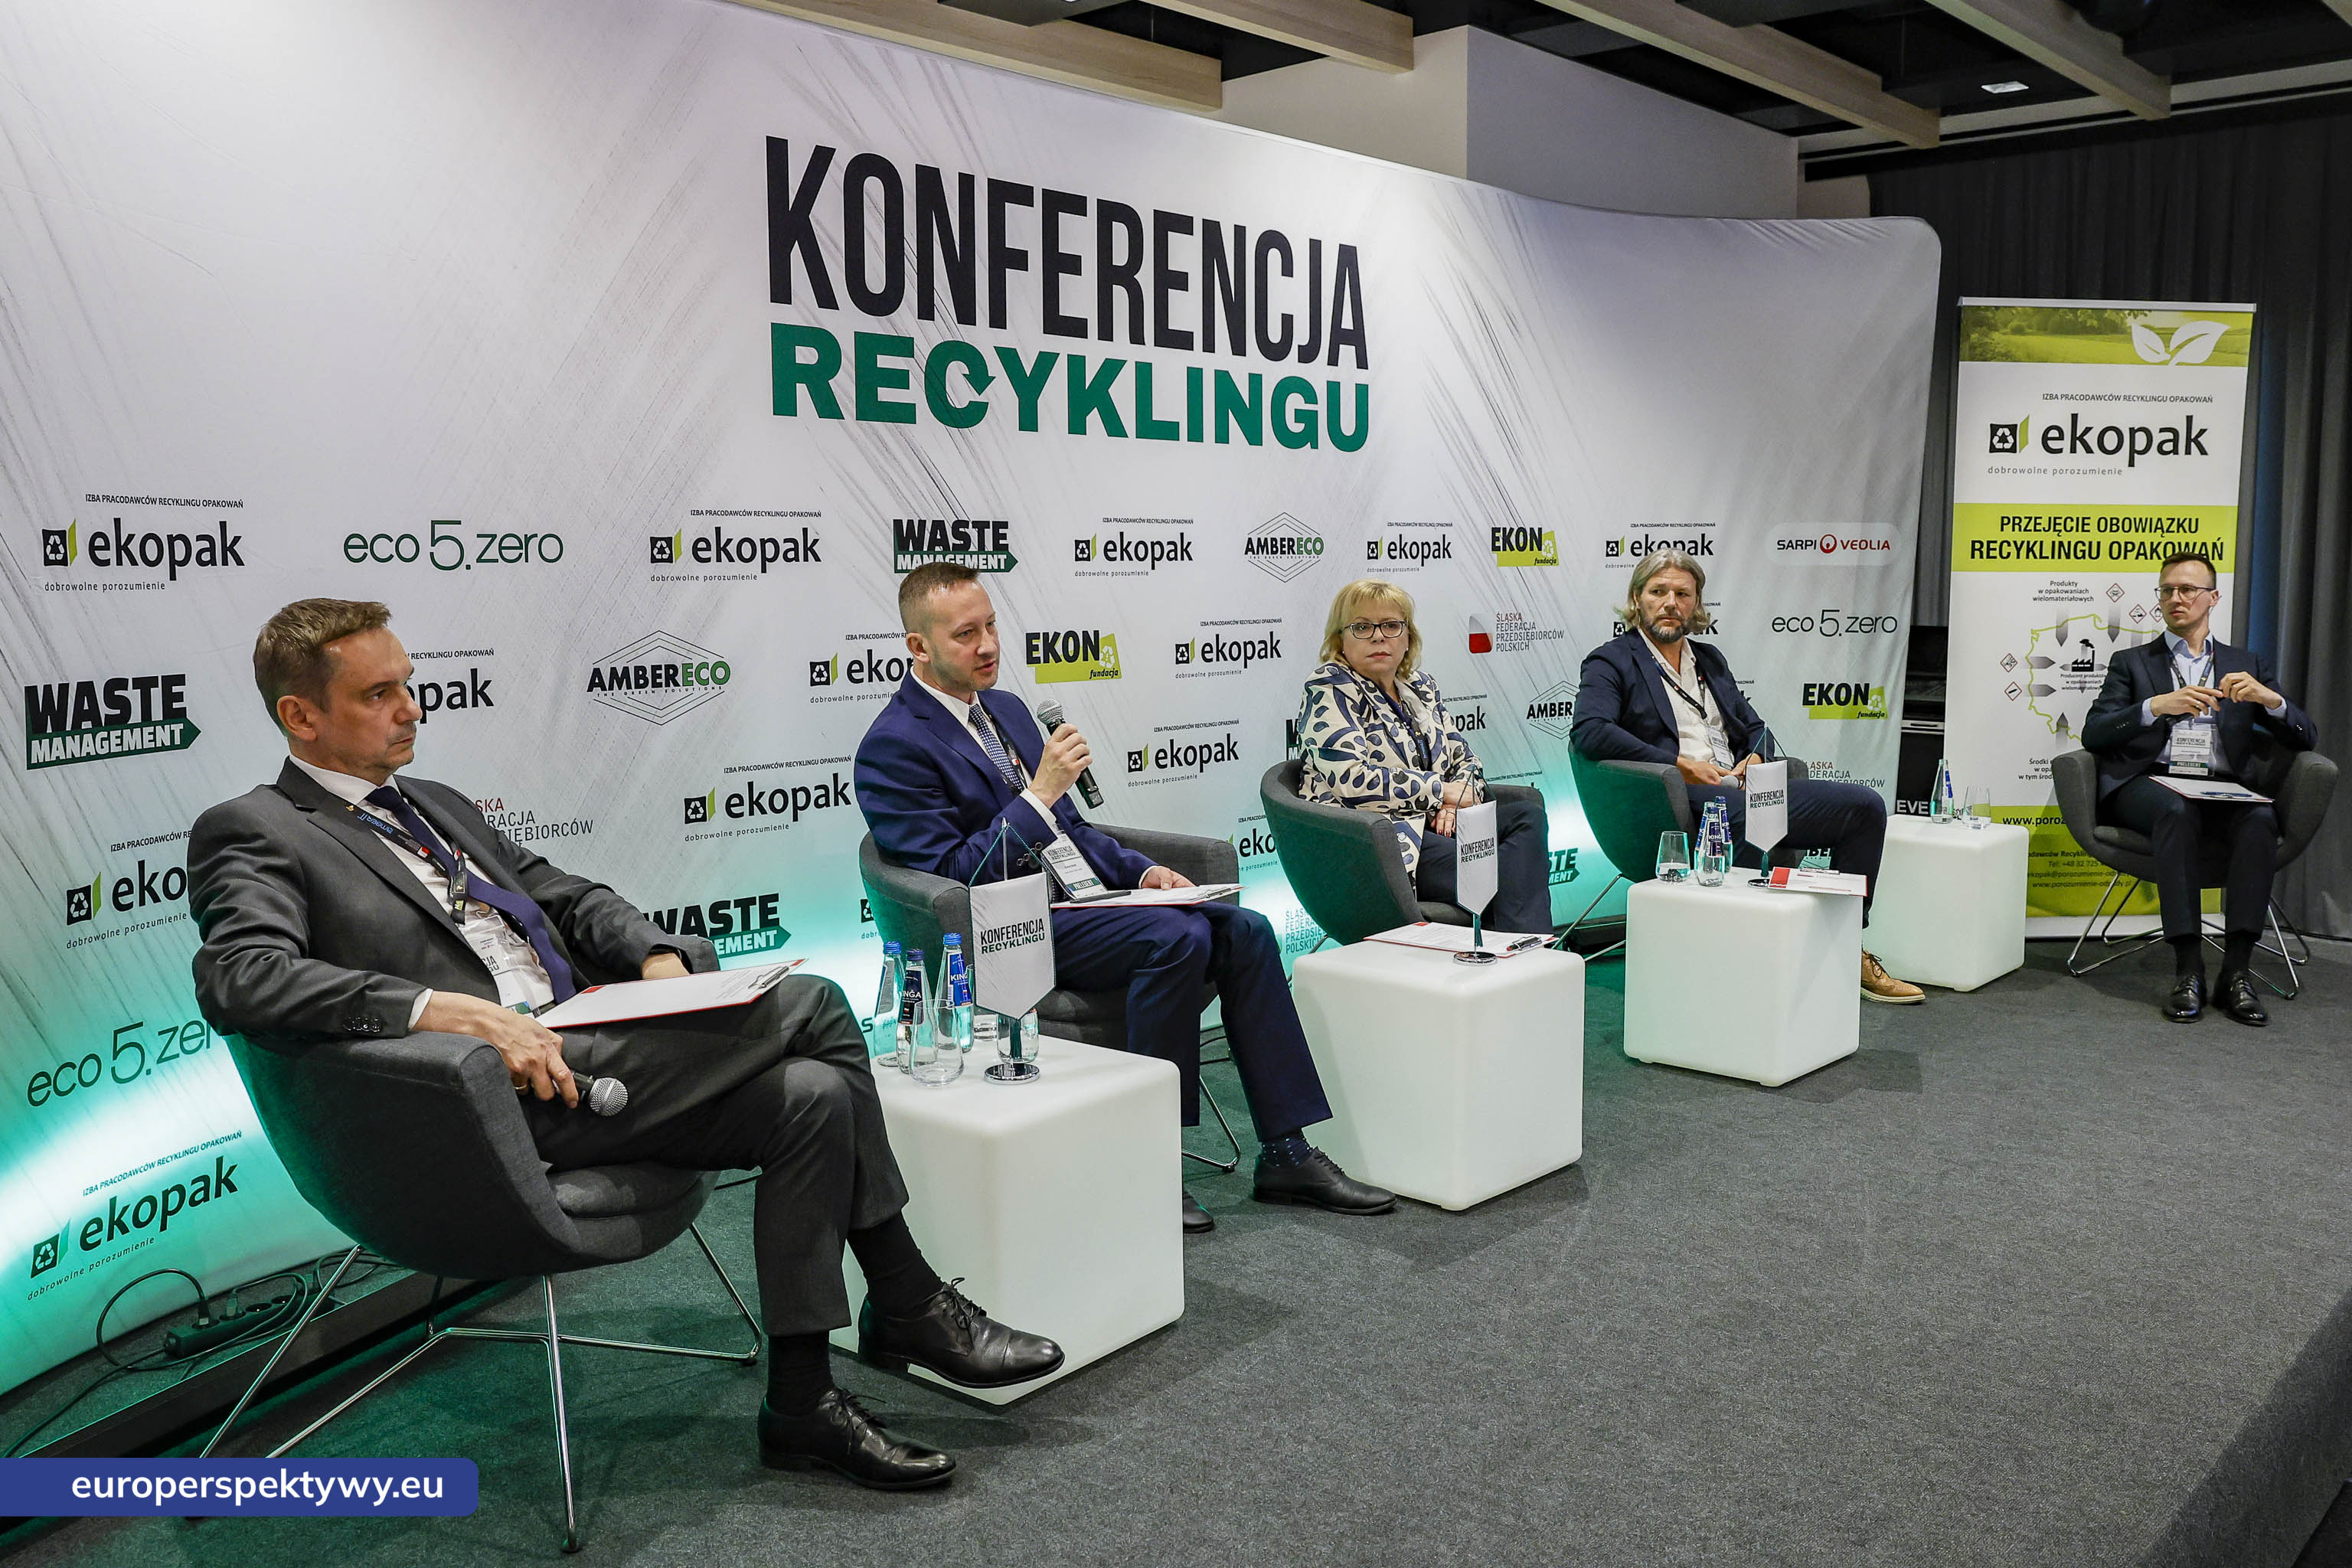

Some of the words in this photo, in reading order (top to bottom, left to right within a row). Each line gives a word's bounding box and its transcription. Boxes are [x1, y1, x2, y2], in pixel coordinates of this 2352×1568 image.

[766, 134, 1369, 371] KONFERENCJA
[770, 322, 1370, 452] RECYKLINGU
[2060, 393, 2122, 401] PRACODAWCÓW
[2041, 413, 2209, 468] ekopak
[1988, 466, 2047, 475] dobrowolne
[2052, 467, 2123, 476] porozumienie
[85, 494, 100, 502] IZBA
[102, 495, 157, 505] PRACODAWCÓW
[158, 498, 201, 507] RECYKLINGU
[202, 499, 243, 508] OPAKOWAŃ
[893, 519, 1009, 552] WASTE
[2000, 515, 2091, 537] PRZEJĘCIE
[2096, 516, 2199, 537] OBOWIĄZKU
[88, 518, 245, 581] ekopak
[344, 534, 420, 564] eco
[691, 527, 822, 573] ekopak
[1244, 537, 1324, 555] AMBERECO
[1491, 527, 1542, 551] EKON
[1777, 539, 1817, 550] SARPI
[1840, 539, 1890, 550] VEOLIA
[1970, 539, 2101, 560] RECYKLINGU
[1103, 531, 1193, 570] ekopak
[1387, 534, 1452, 567] ekopak
[1534, 557, 1557, 566] fundacja
[44, 582, 98, 592] dobrowolne
[103, 582, 165, 593] porozumienie
[704, 573, 757, 582] porozumienie
[1496, 612, 1522, 622] ŚLĄSKA
[1496, 622, 1536, 632] FEDERACJA
[1772, 616, 1815, 632] eco
[858, 632, 900, 640] PRACODAWCÓW
[1496, 629, 1564, 642] PRZEDSIĘBIORCÓW
[1496, 641, 1530, 652] POLSKICH
[411, 651, 452, 659] RECYKLINGU
[454, 648, 495, 657] OPAKOWAŃ
[1026, 630, 1099, 665] EKON
[1201, 631, 1282, 668] ekopak
[586, 661, 731, 692] AMBERECO
[847, 648, 913, 684] eko
[1089, 668, 1119, 679] fundacja
[24, 674, 188, 733] WASTE
[407, 668, 495, 724] pak
[810, 694, 854, 704] dobrowolne
[1802, 683, 1870, 706] EKON
[1527, 701, 1573, 720] AMBER
[1857, 710, 1885, 719] fundacja
[31, 722, 185, 764] MANAGEMENT
[1155, 733, 1239, 773] ekopak
[738, 762, 785, 773] PRACODAWCÓW
[786, 759, 819, 768] RECYKLINGU
[819, 755, 851, 764] OPAKOWAŃ
[1810, 770, 1851, 779] DERACJA
[1128, 779, 1160, 787] dobrowolne
[1162, 774, 1197, 784] porozumienie
[475, 798, 505, 812] SKA
[725, 773, 852, 822] ekopak
[1749, 789, 1784, 803] KONFERENCJA
[1750, 799, 1785, 808] RECYKLINGU
[487, 810, 536, 828] RACJA
[110, 843, 126, 852] IZBA
[126, 831, 181, 850] PRACODAWCÓW
[685, 831, 733, 841] dobrowolne
[737, 823, 789, 837] porozumienie
[1239, 828, 1276, 858] eko
[112, 859, 188, 912] eko
[66, 928, 120, 949] dobrowolne
[124, 912, 188, 936] porozumienie
[980, 918, 1044, 946] KONFERENCJA
[714, 929, 778, 955] EMENT
[981, 933, 1045, 955] RECYKLINGU
[27, 1053, 103, 1106] eco
[83, 1184, 99, 1197] IZBA
[100, 1161, 156, 1189] PRACODAWCÓW
[157, 1145, 200, 1167] RECYKLINGU
[200, 1130, 243, 1151] OPAKOWAŃ
[80, 1155, 238, 1251] ekopak
[27, 1267, 84, 1301] dobrowolne
[88, 1236, 155, 1272] porozumienie
